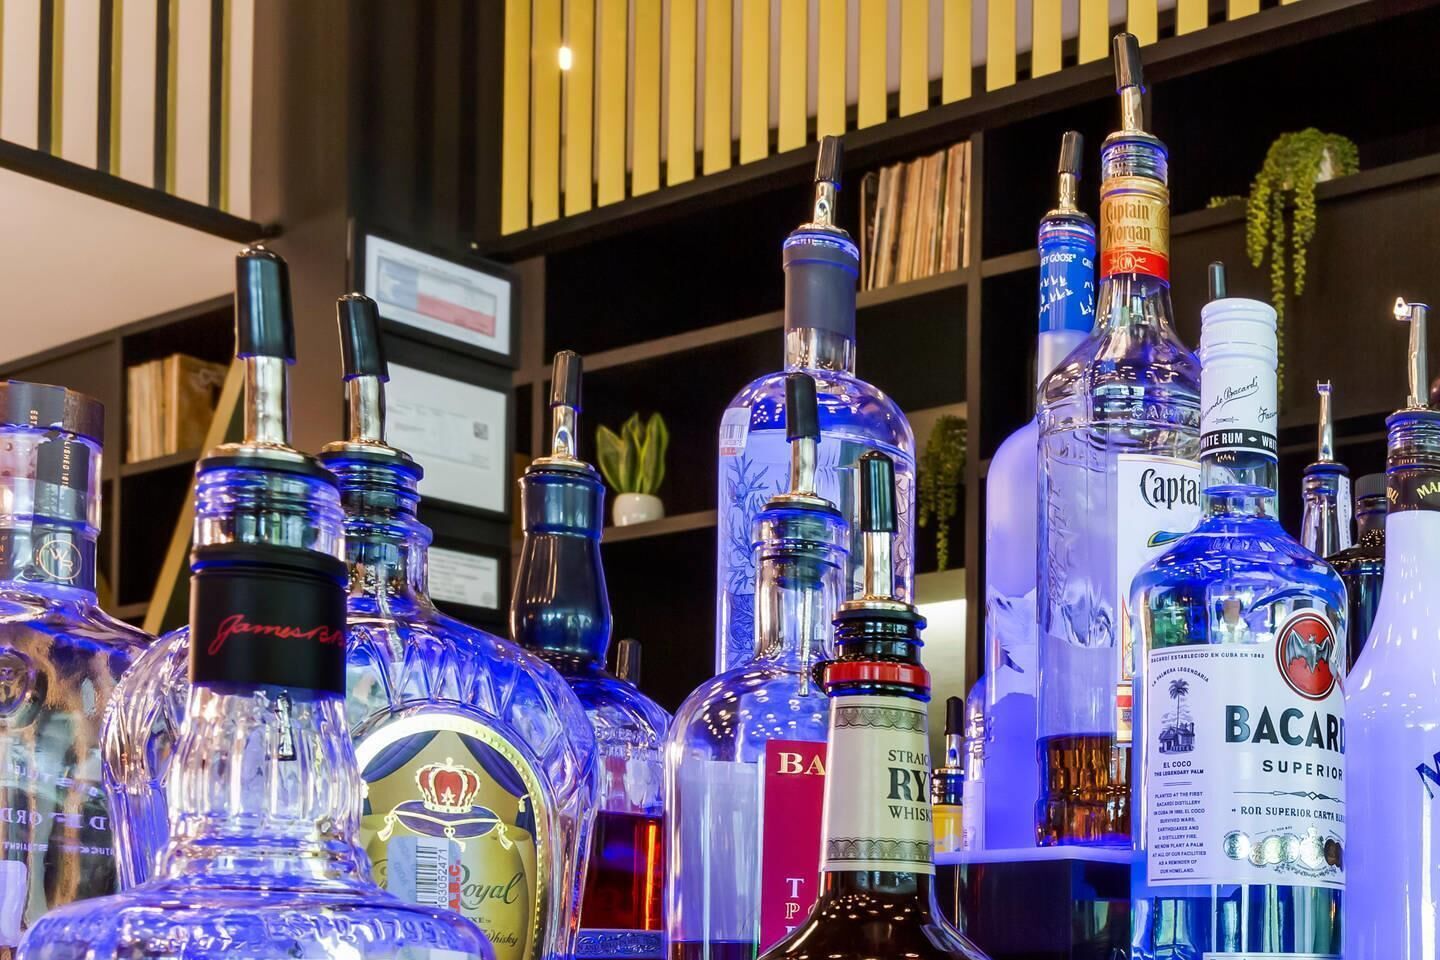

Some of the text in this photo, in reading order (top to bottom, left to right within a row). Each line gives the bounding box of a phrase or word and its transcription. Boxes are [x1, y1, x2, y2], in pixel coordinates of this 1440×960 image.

[1105, 201, 1149, 223] Captain
[1106, 225, 1151, 248] Morgan
[1222, 432, 1243, 445] RUM
[1156, 666, 1209, 682] PALMERA LEGENDARIA
[1225, 705, 1345, 755] BACARD
[1162, 769, 1189, 777] LEGENDARY
[1262, 760, 1343, 781] SUPERIOR
[886, 767, 930, 802] RY
[889, 806, 932, 822] WHISK
[1241, 806, 1261, 815] RON
[1265, 806, 1311, 818] SUPERIOR
[1314, 810, 1334, 821] CARTA
